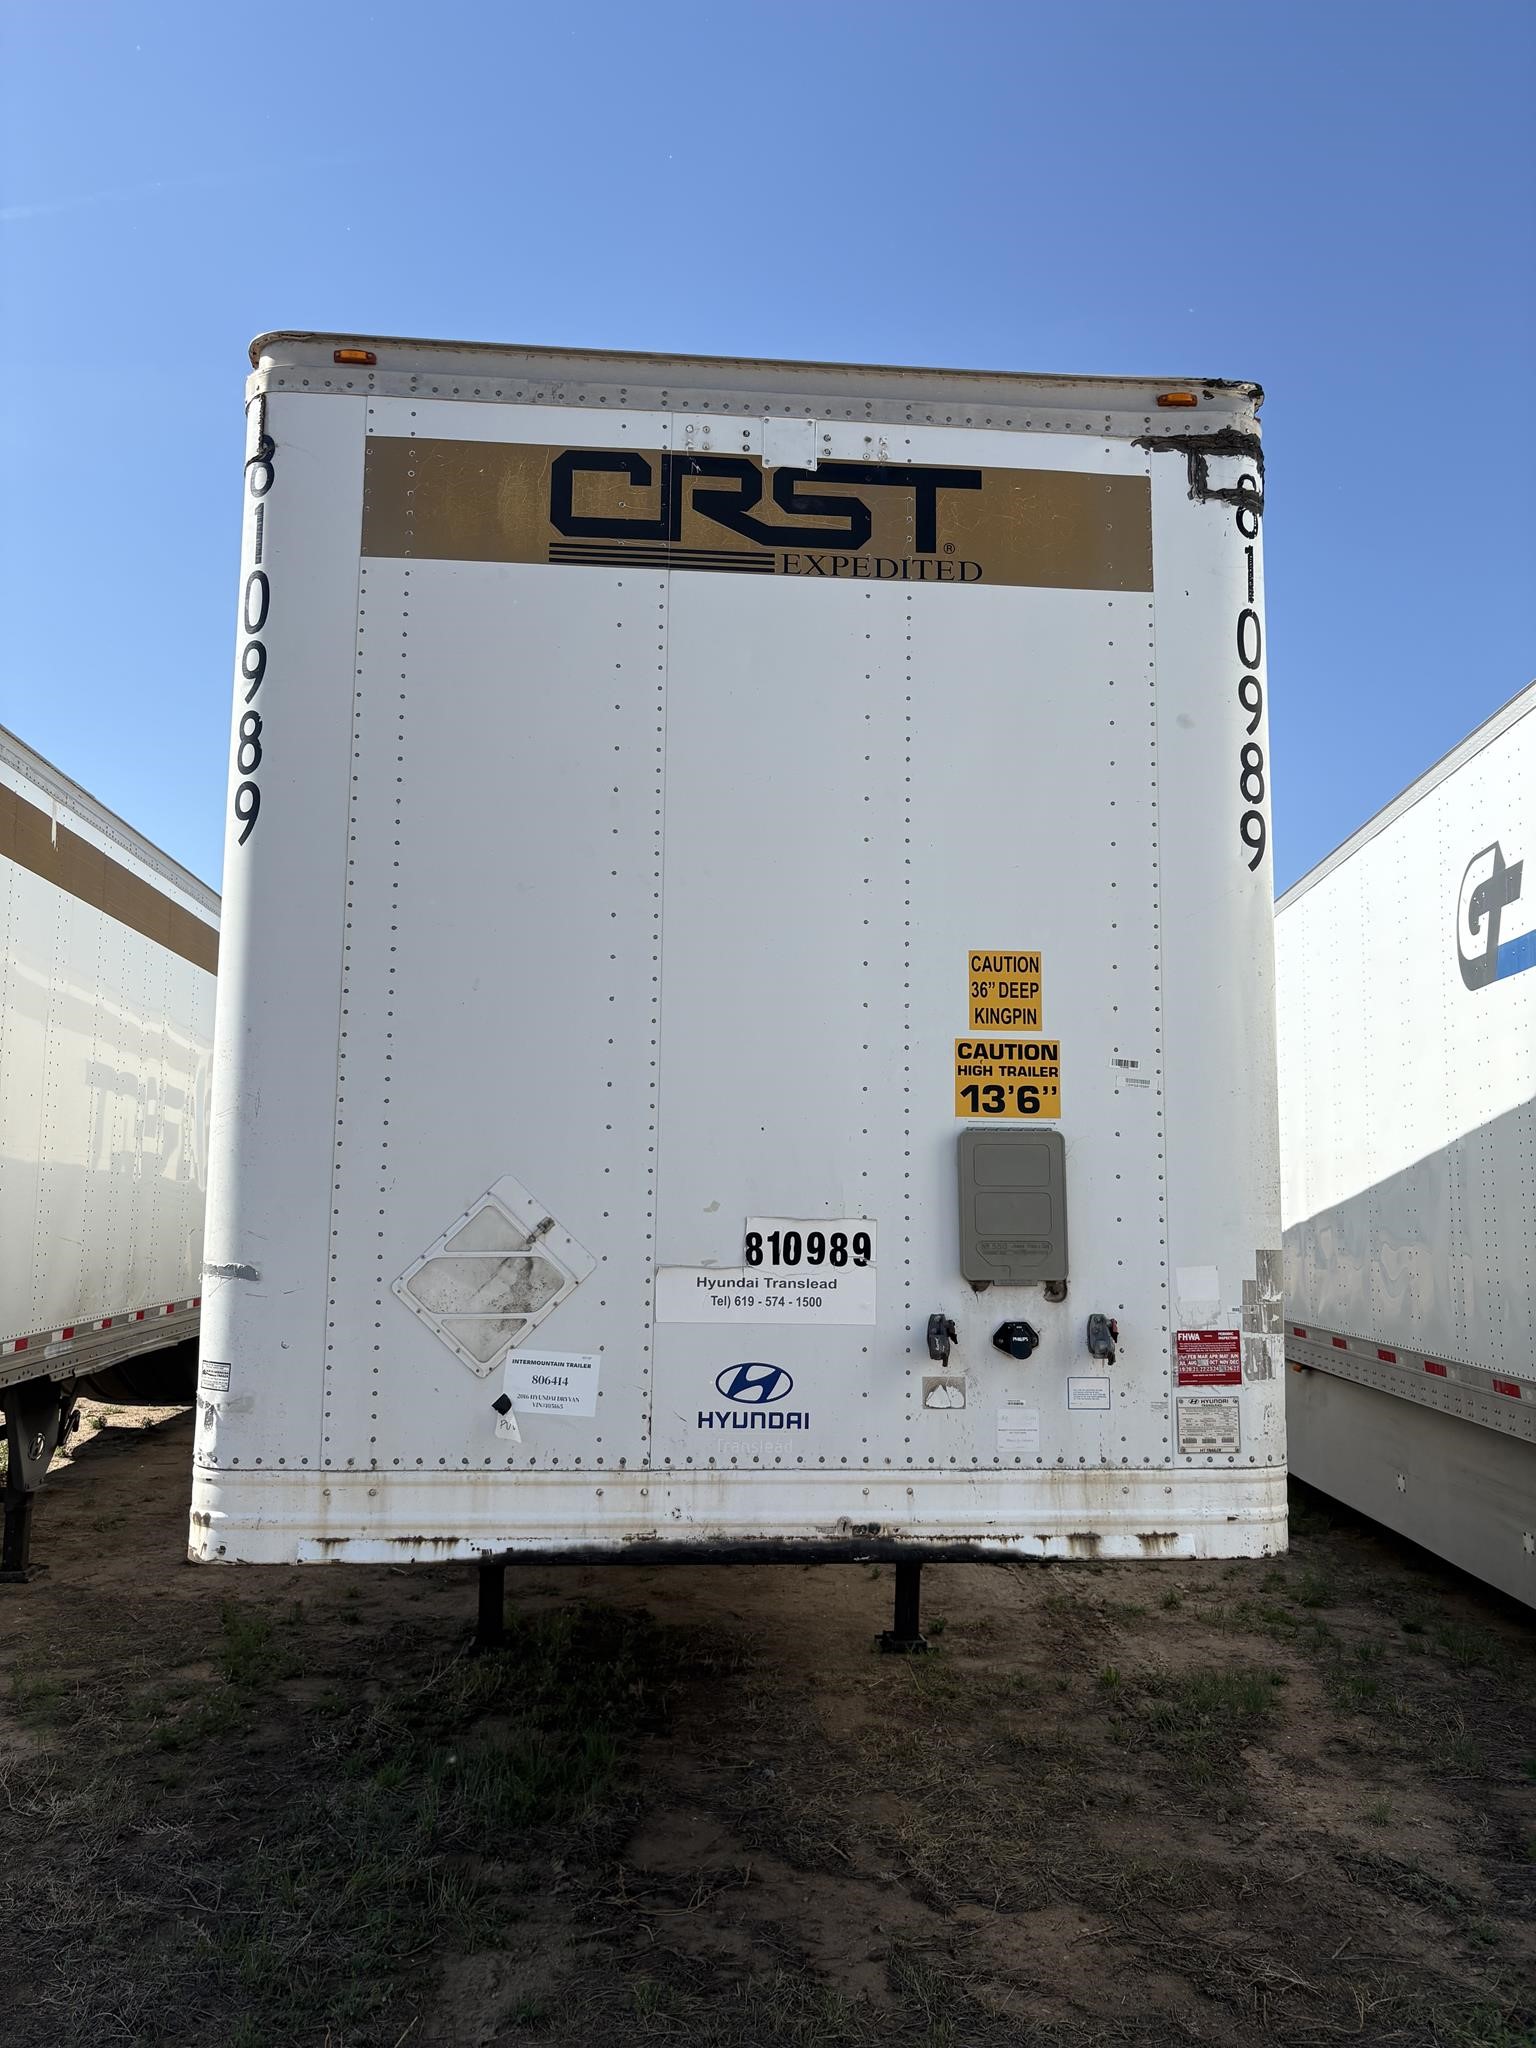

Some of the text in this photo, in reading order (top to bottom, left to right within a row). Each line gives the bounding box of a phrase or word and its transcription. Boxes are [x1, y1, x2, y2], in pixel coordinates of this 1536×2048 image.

[550, 450, 982, 553] CRST
[781, 553, 983, 582] EXPEDITED
[971, 956, 1039, 973] CAUTION
[999, 982, 1039, 998] DEEP
[974, 1008, 1037, 1025] KINGPIN
[957, 1043, 1058, 1061] CAUTION
[957, 1065, 1059, 1078] HIGH TRAILER
[745, 1231, 872, 1267] 810989
[696, 1276, 838, 1291] Hyundai Translead
[711, 1295, 731, 1308] Tel)
[734, 1297, 755, 1307] 619
[765, 1298, 786, 1307] 574
[796, 1298, 823, 1308] 1500
[1177, 1332, 1201, 1341] FHWA
[512, 1359, 565, 1368] INTERMOUNTAIN
[531, 1375, 569, 1387] 806414
[698, 1411, 810, 1430] HYUNDAI
